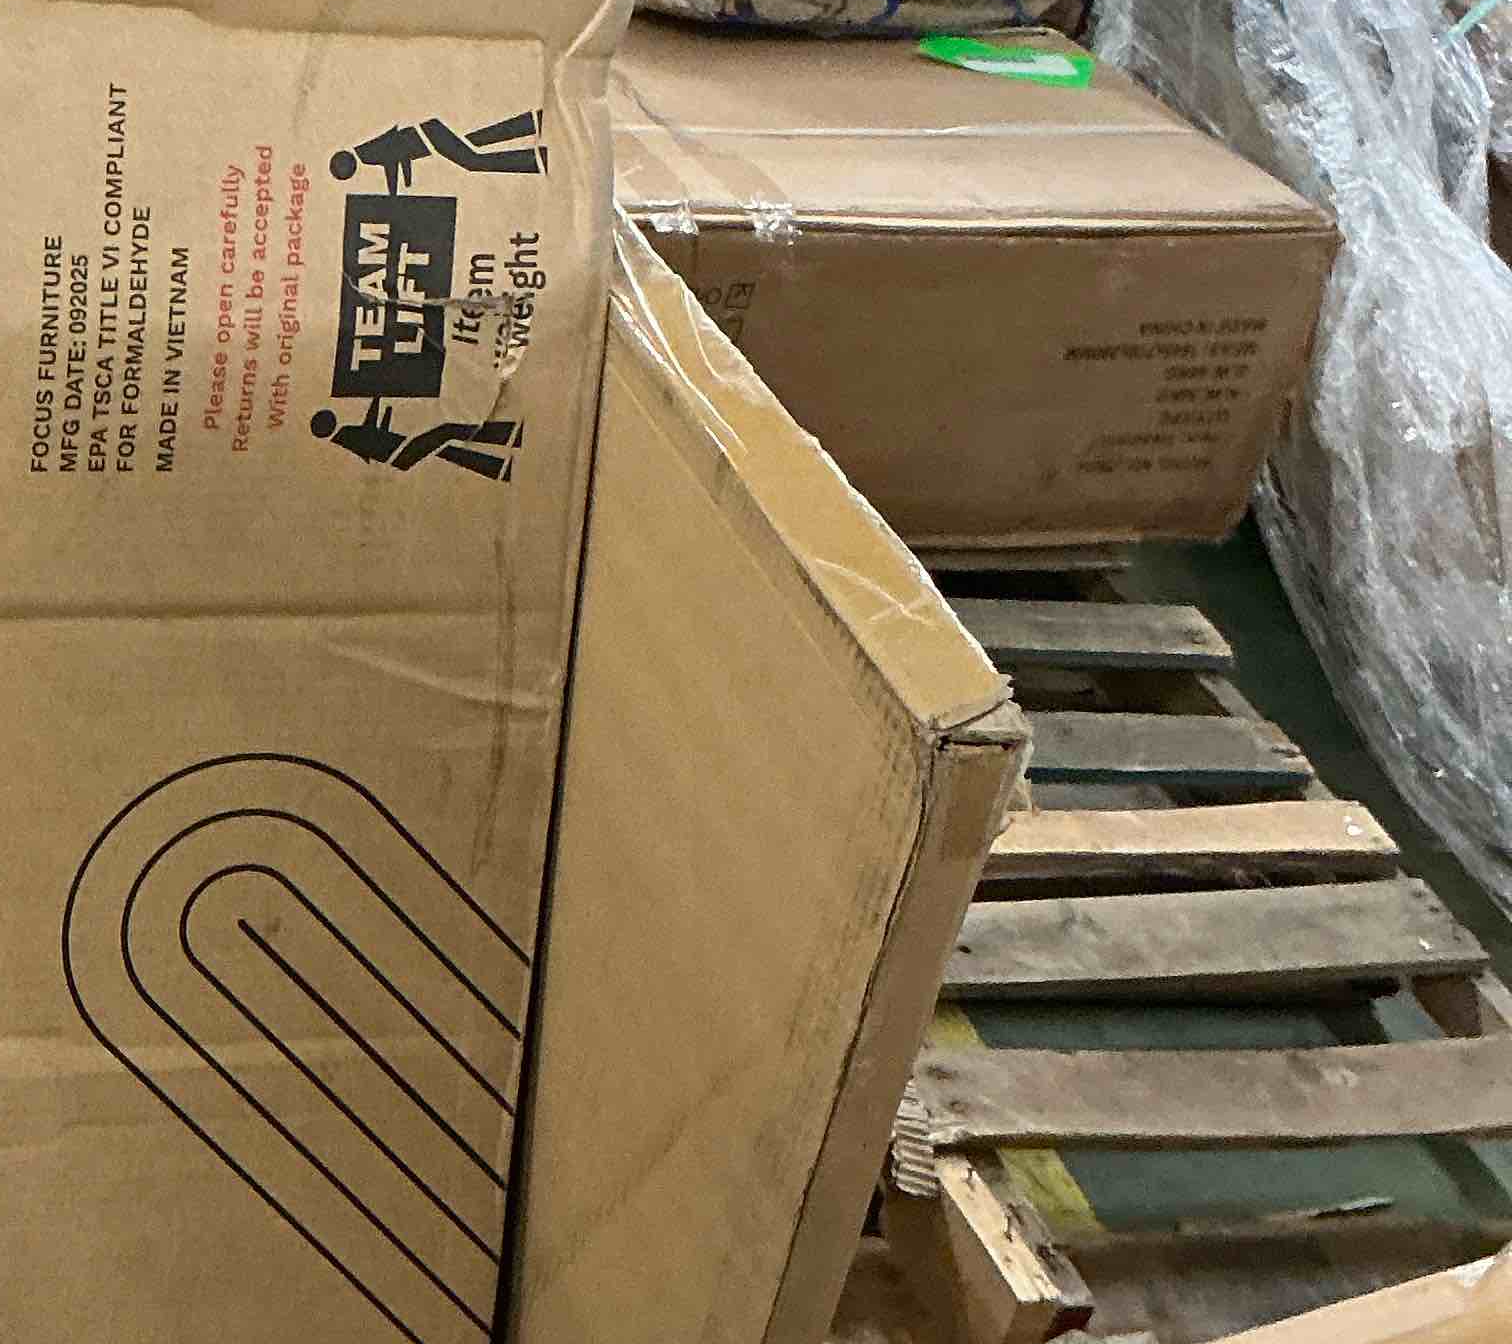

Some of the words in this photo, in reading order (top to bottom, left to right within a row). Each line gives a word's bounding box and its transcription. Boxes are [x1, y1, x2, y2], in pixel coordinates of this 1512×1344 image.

[98, 82, 130, 235] COMPLIANT
[214, 163, 246, 273] carefully
[246, 145, 277, 259] accepted
[283, 162, 311, 265] package
[66, 255, 91, 333] 092025
[101, 245, 119, 268] VI
[244, 270, 266, 298] be
[35, 235, 65, 379] FURNITURE
[96, 276, 120, 348] TITLE
[119, 206, 153, 414] FORMALDEHYDE
[163, 247, 191, 360] VIETNAM
[214, 283, 237, 342] open
[241, 307, 262, 350] will
[275, 275, 303, 364] original
[349, 222, 392, 370] TEAM
[392, 242, 430, 353] LIFT
[63, 341, 86, 409] DATE:
[91, 356, 114, 419] TSCA
[161, 369, 180, 392] IN
[202, 351, 228, 429] Please
[231, 358, 258, 452] Returns
[267, 375, 290, 428] With
[30, 389, 54, 472] FOCUS
[59, 419, 80, 472] MFG
[87, 427, 108, 472] EPA
[116, 423, 137, 472] FOR
[155, 401, 178, 472] MADE
